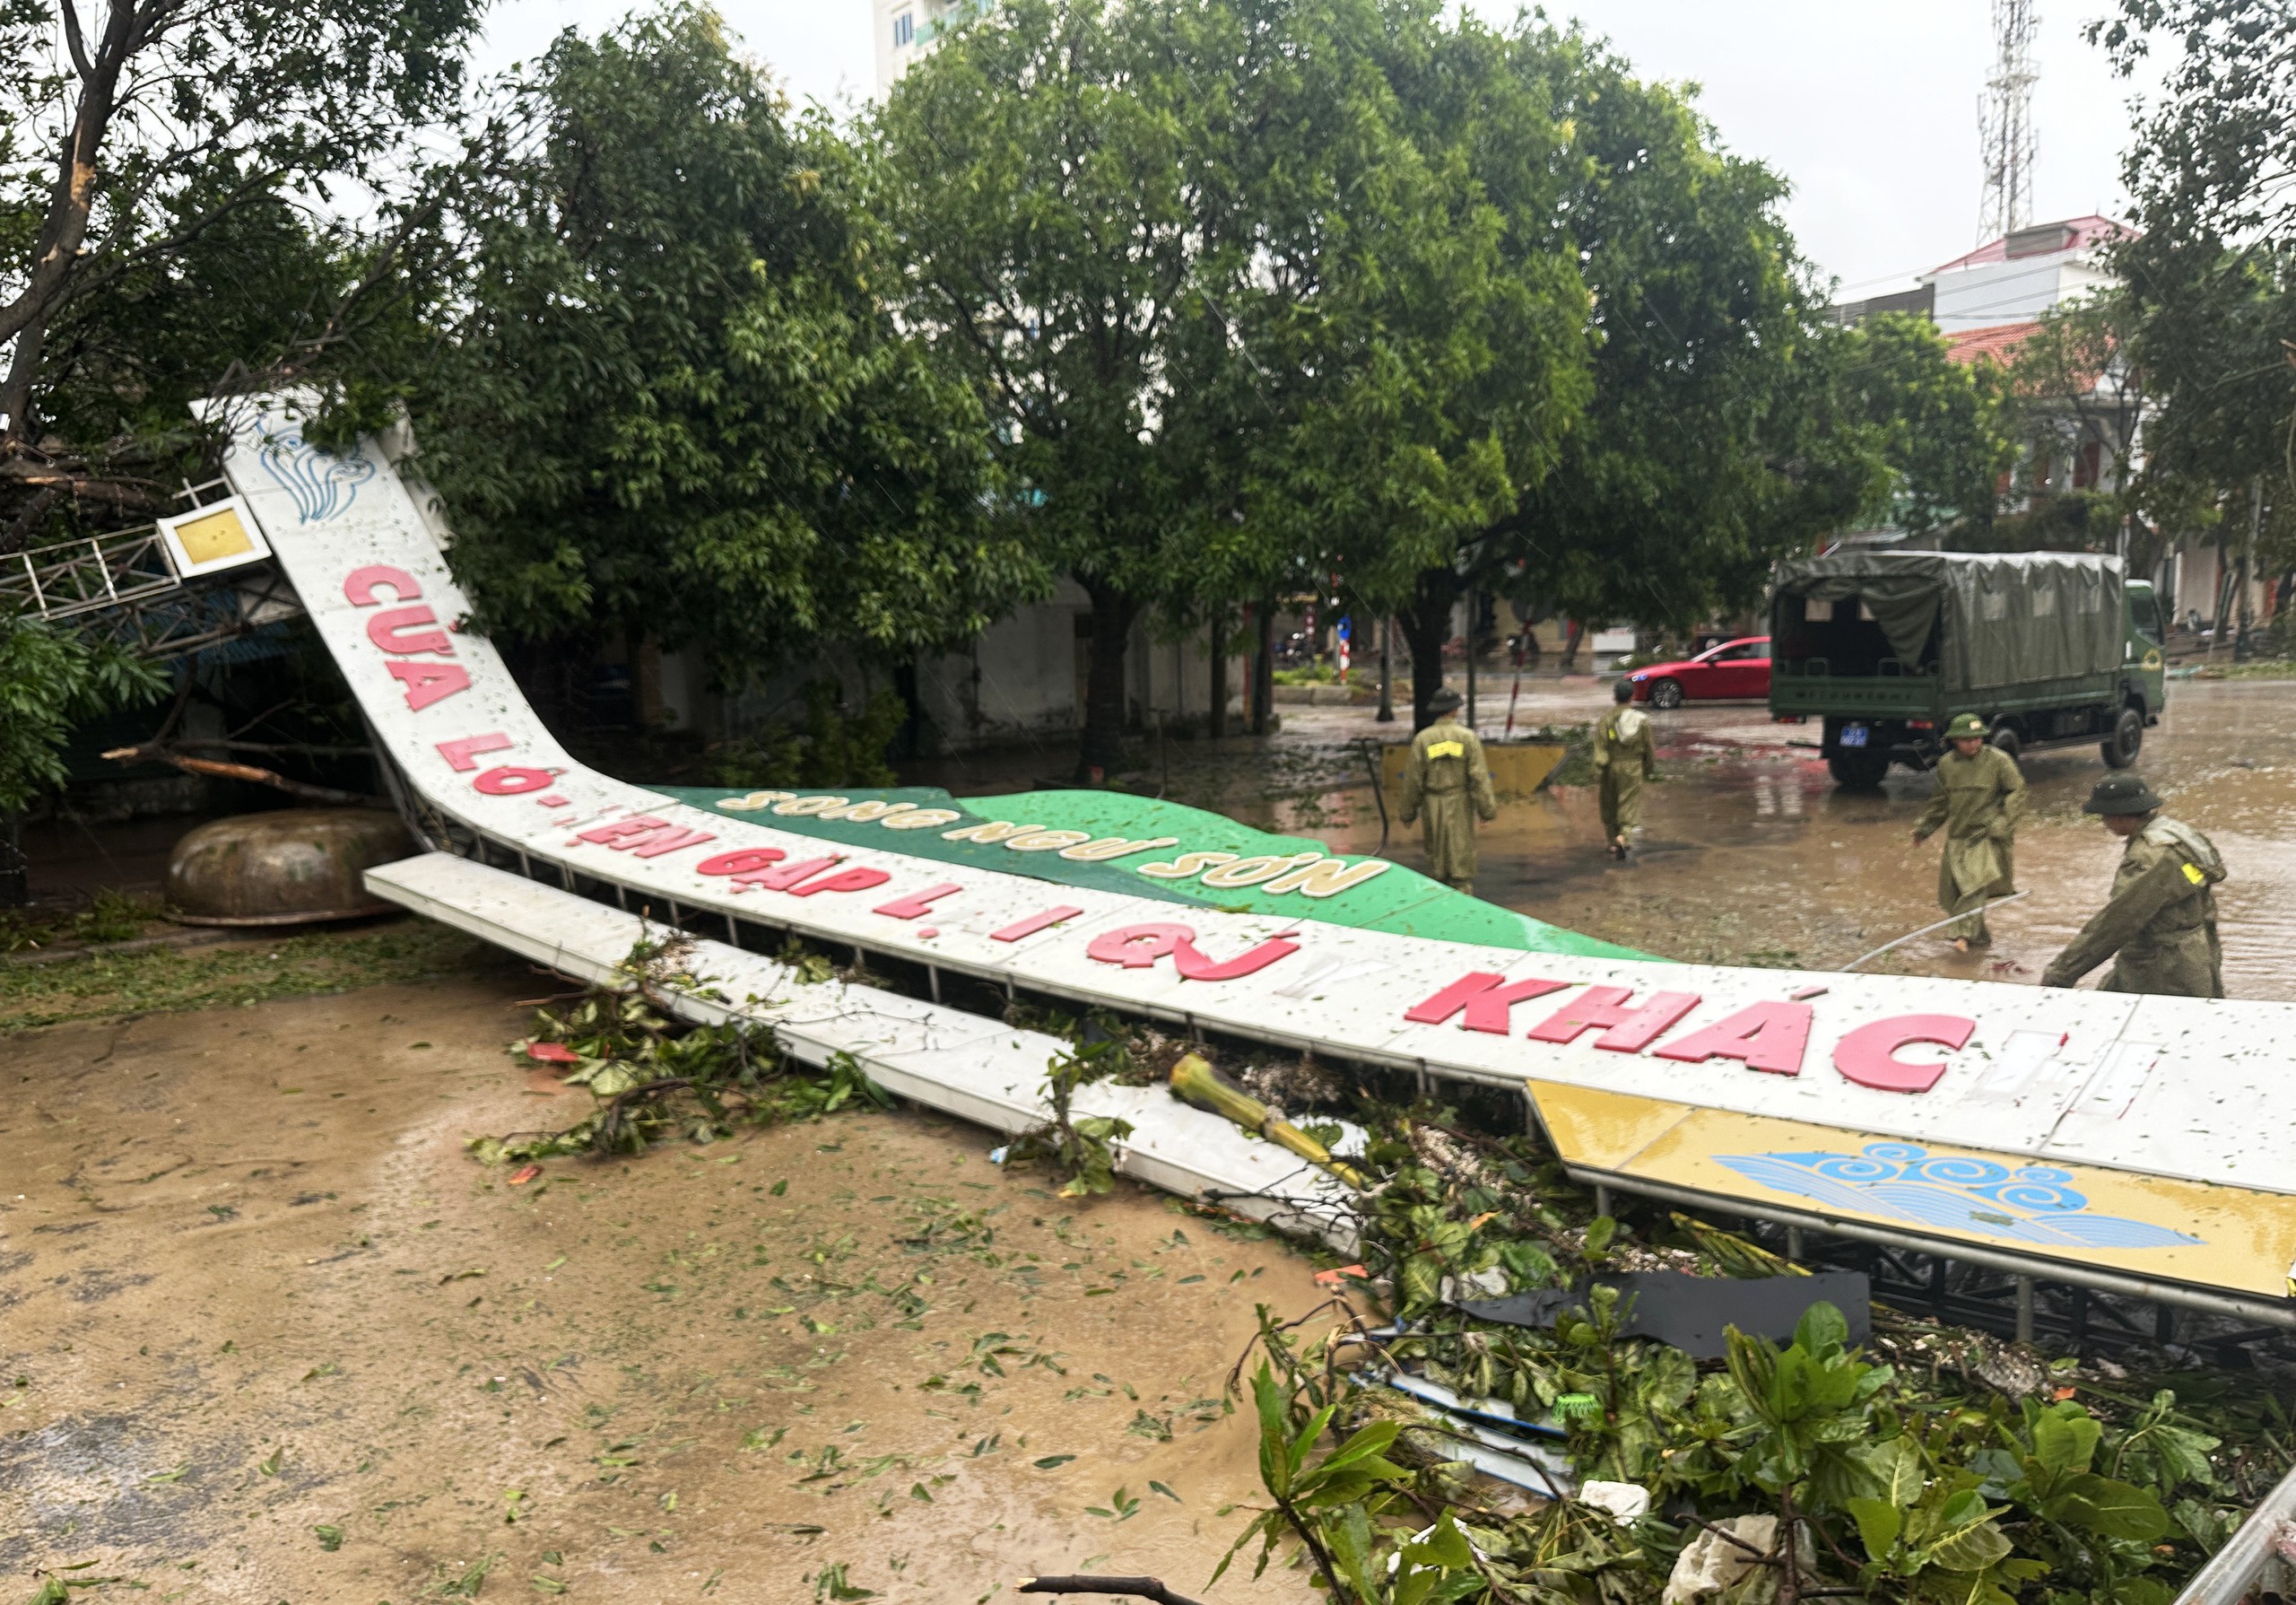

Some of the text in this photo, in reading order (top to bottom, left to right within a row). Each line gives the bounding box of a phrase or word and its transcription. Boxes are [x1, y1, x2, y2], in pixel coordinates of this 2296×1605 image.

[716, 790, 1391, 898] SONG NGƯ SƠN
